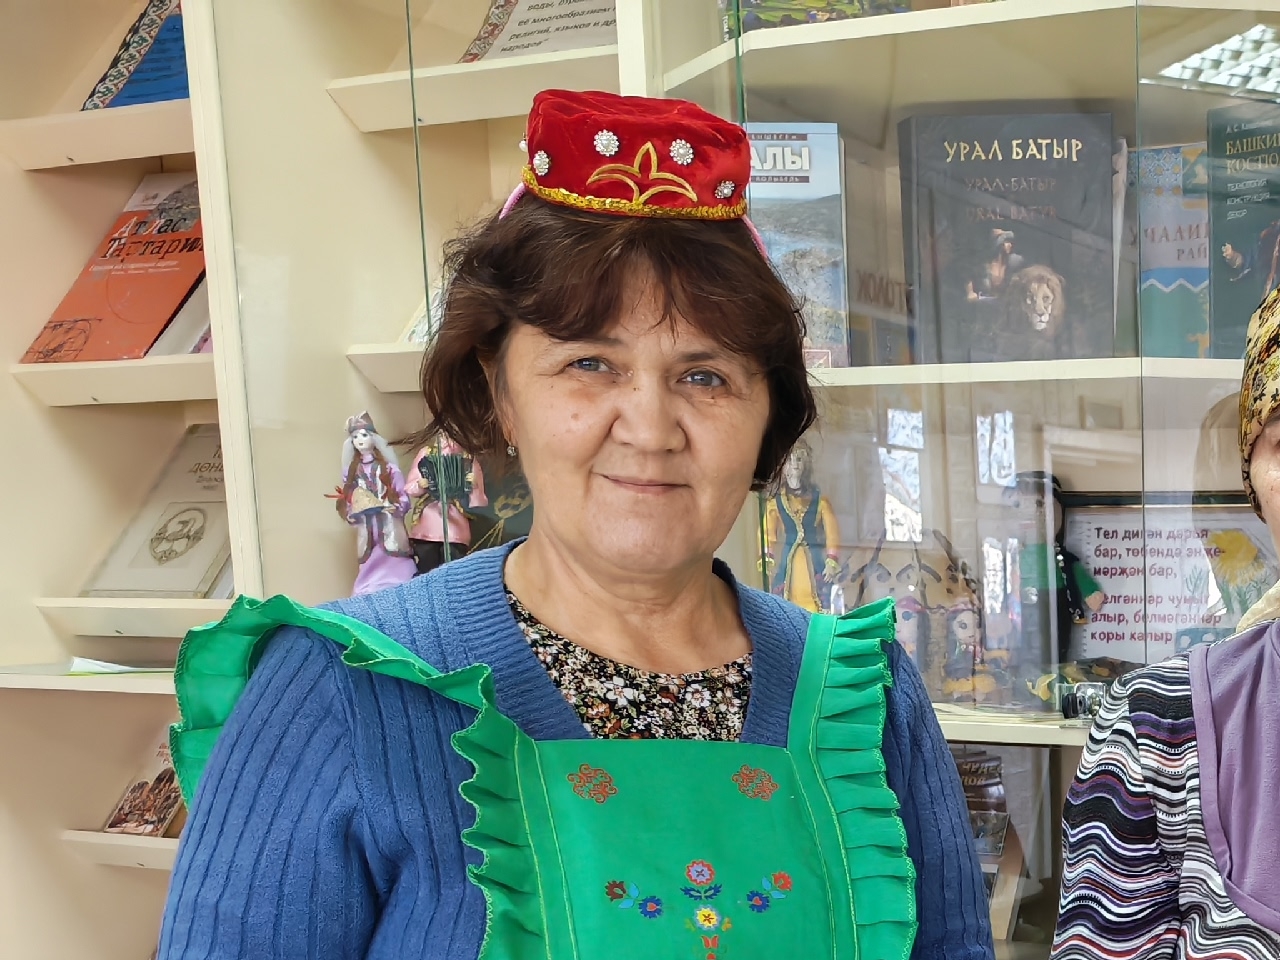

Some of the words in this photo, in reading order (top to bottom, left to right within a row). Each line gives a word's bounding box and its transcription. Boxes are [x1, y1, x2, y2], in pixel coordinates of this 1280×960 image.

[943, 138, 1003, 163] УРАЛ
[1011, 138, 1083, 162] БАТЫР
[1094, 527, 1118, 540] Тел
[1094, 544, 1123, 560] бар,
[1149, 562, 1178, 579] бар,
[1091, 612, 1129, 626] алыр,
[1090, 631, 1125, 644] коры
